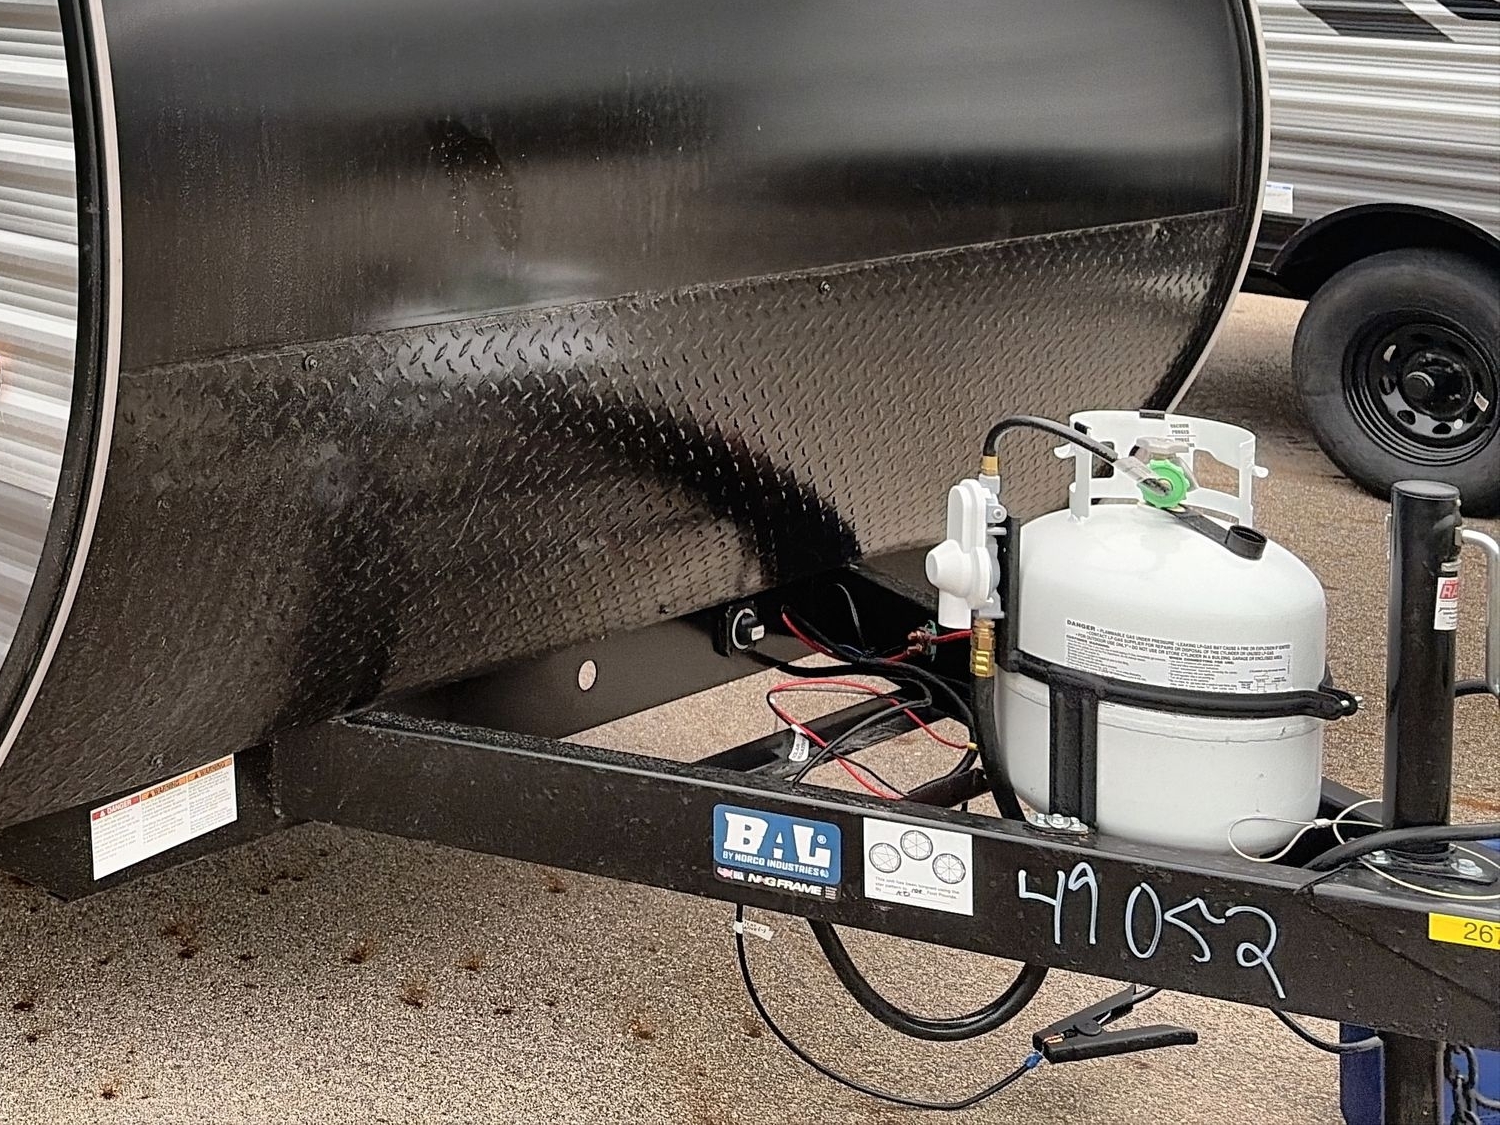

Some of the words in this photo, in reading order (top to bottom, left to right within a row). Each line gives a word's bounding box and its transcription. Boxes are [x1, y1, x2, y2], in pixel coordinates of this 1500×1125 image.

[1067, 619, 1095, 631] DANGER
[107, 799, 132, 814] DANGER
[722, 850, 734, 860] BY
[735, 853, 765, 866] NORCO
[767, 859, 819, 877] INDUSTRIES
[776, 879, 822, 895] FRAME
